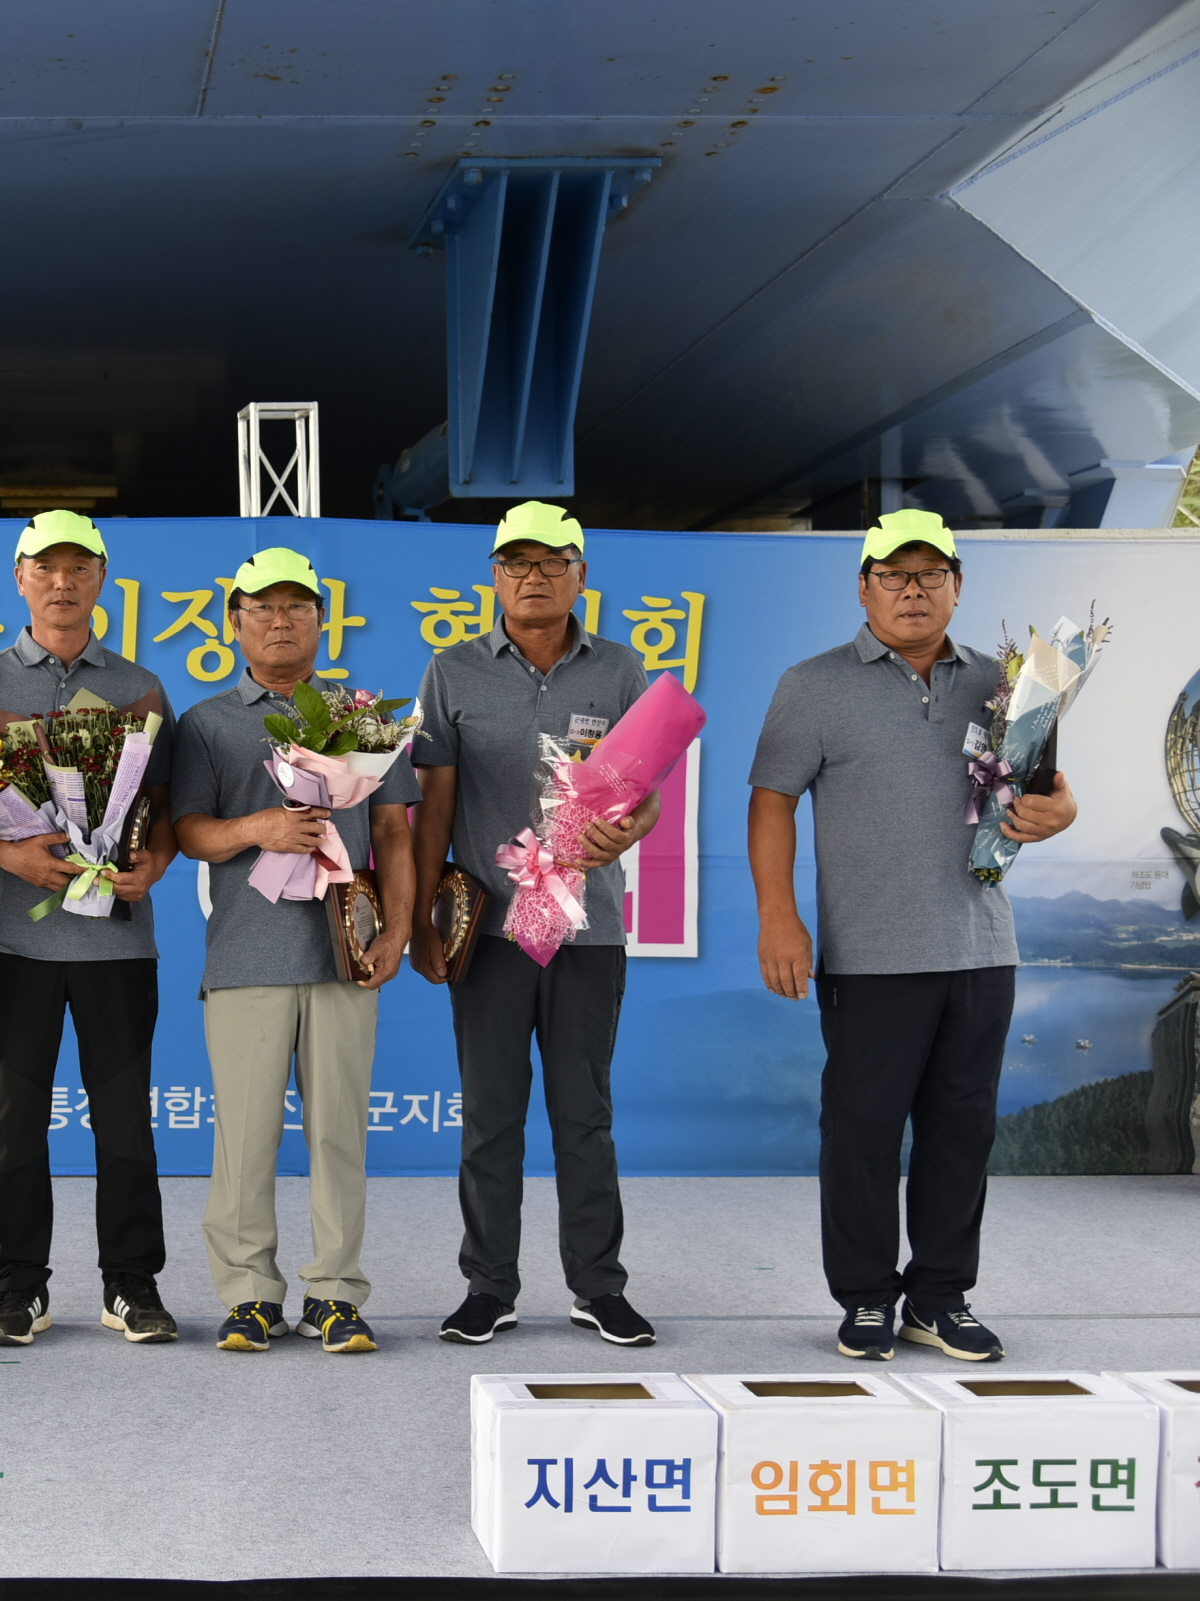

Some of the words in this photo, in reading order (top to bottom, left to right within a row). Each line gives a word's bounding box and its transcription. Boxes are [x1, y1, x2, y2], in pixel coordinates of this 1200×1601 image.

[411, 584, 705, 694] 협회
[524, 1457, 692, 1513] 지산면
[751, 1459, 917, 1516] 임회면
[972, 1458, 1136, 1512] 조도면
